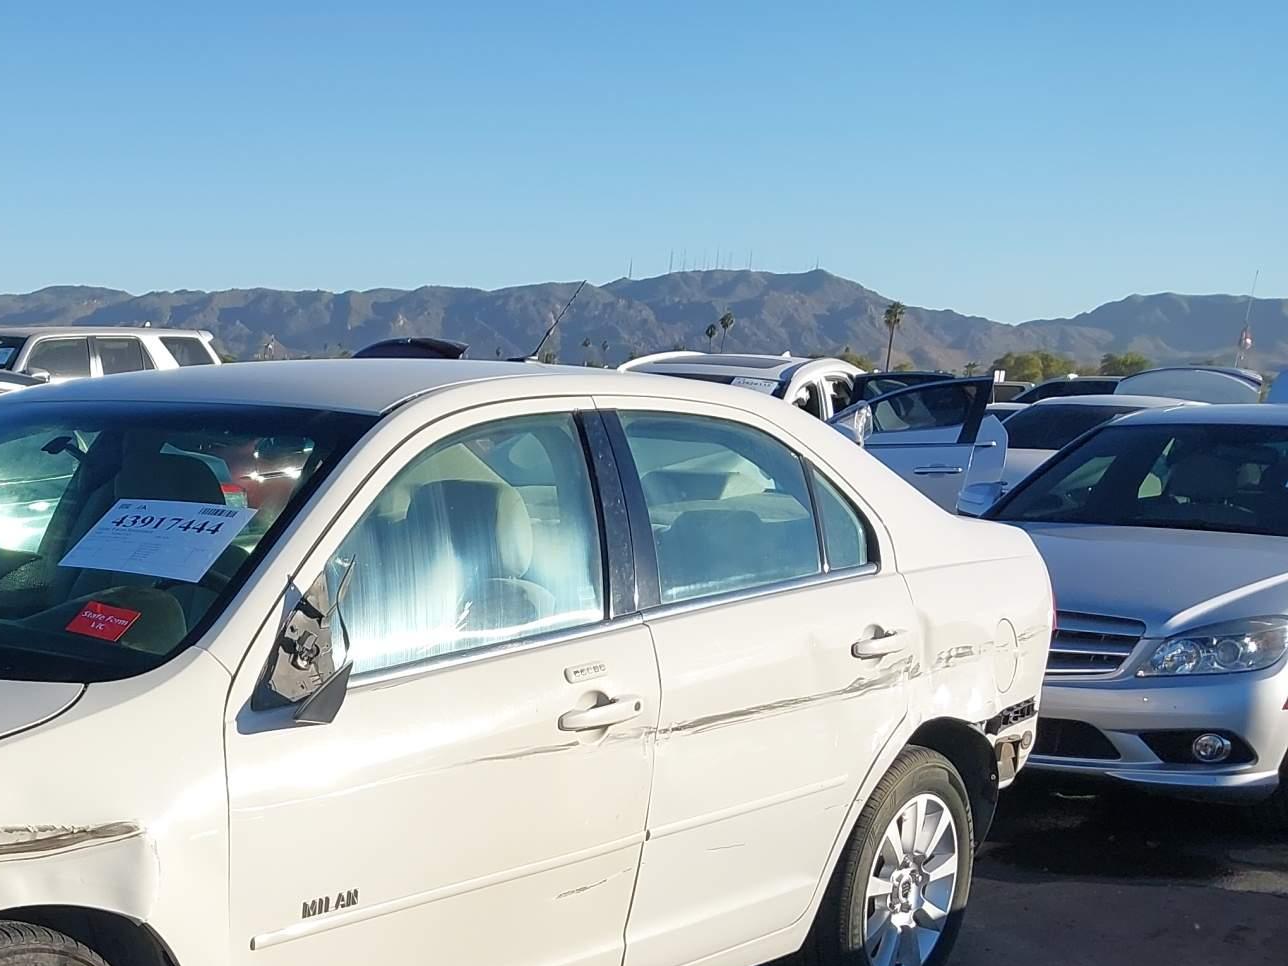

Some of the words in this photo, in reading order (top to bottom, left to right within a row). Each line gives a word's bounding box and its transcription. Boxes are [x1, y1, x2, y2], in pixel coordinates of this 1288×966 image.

[111, 513, 226, 535] 43917444
[82, 610, 106, 621] State
[301, 888, 359, 919] MILAN
